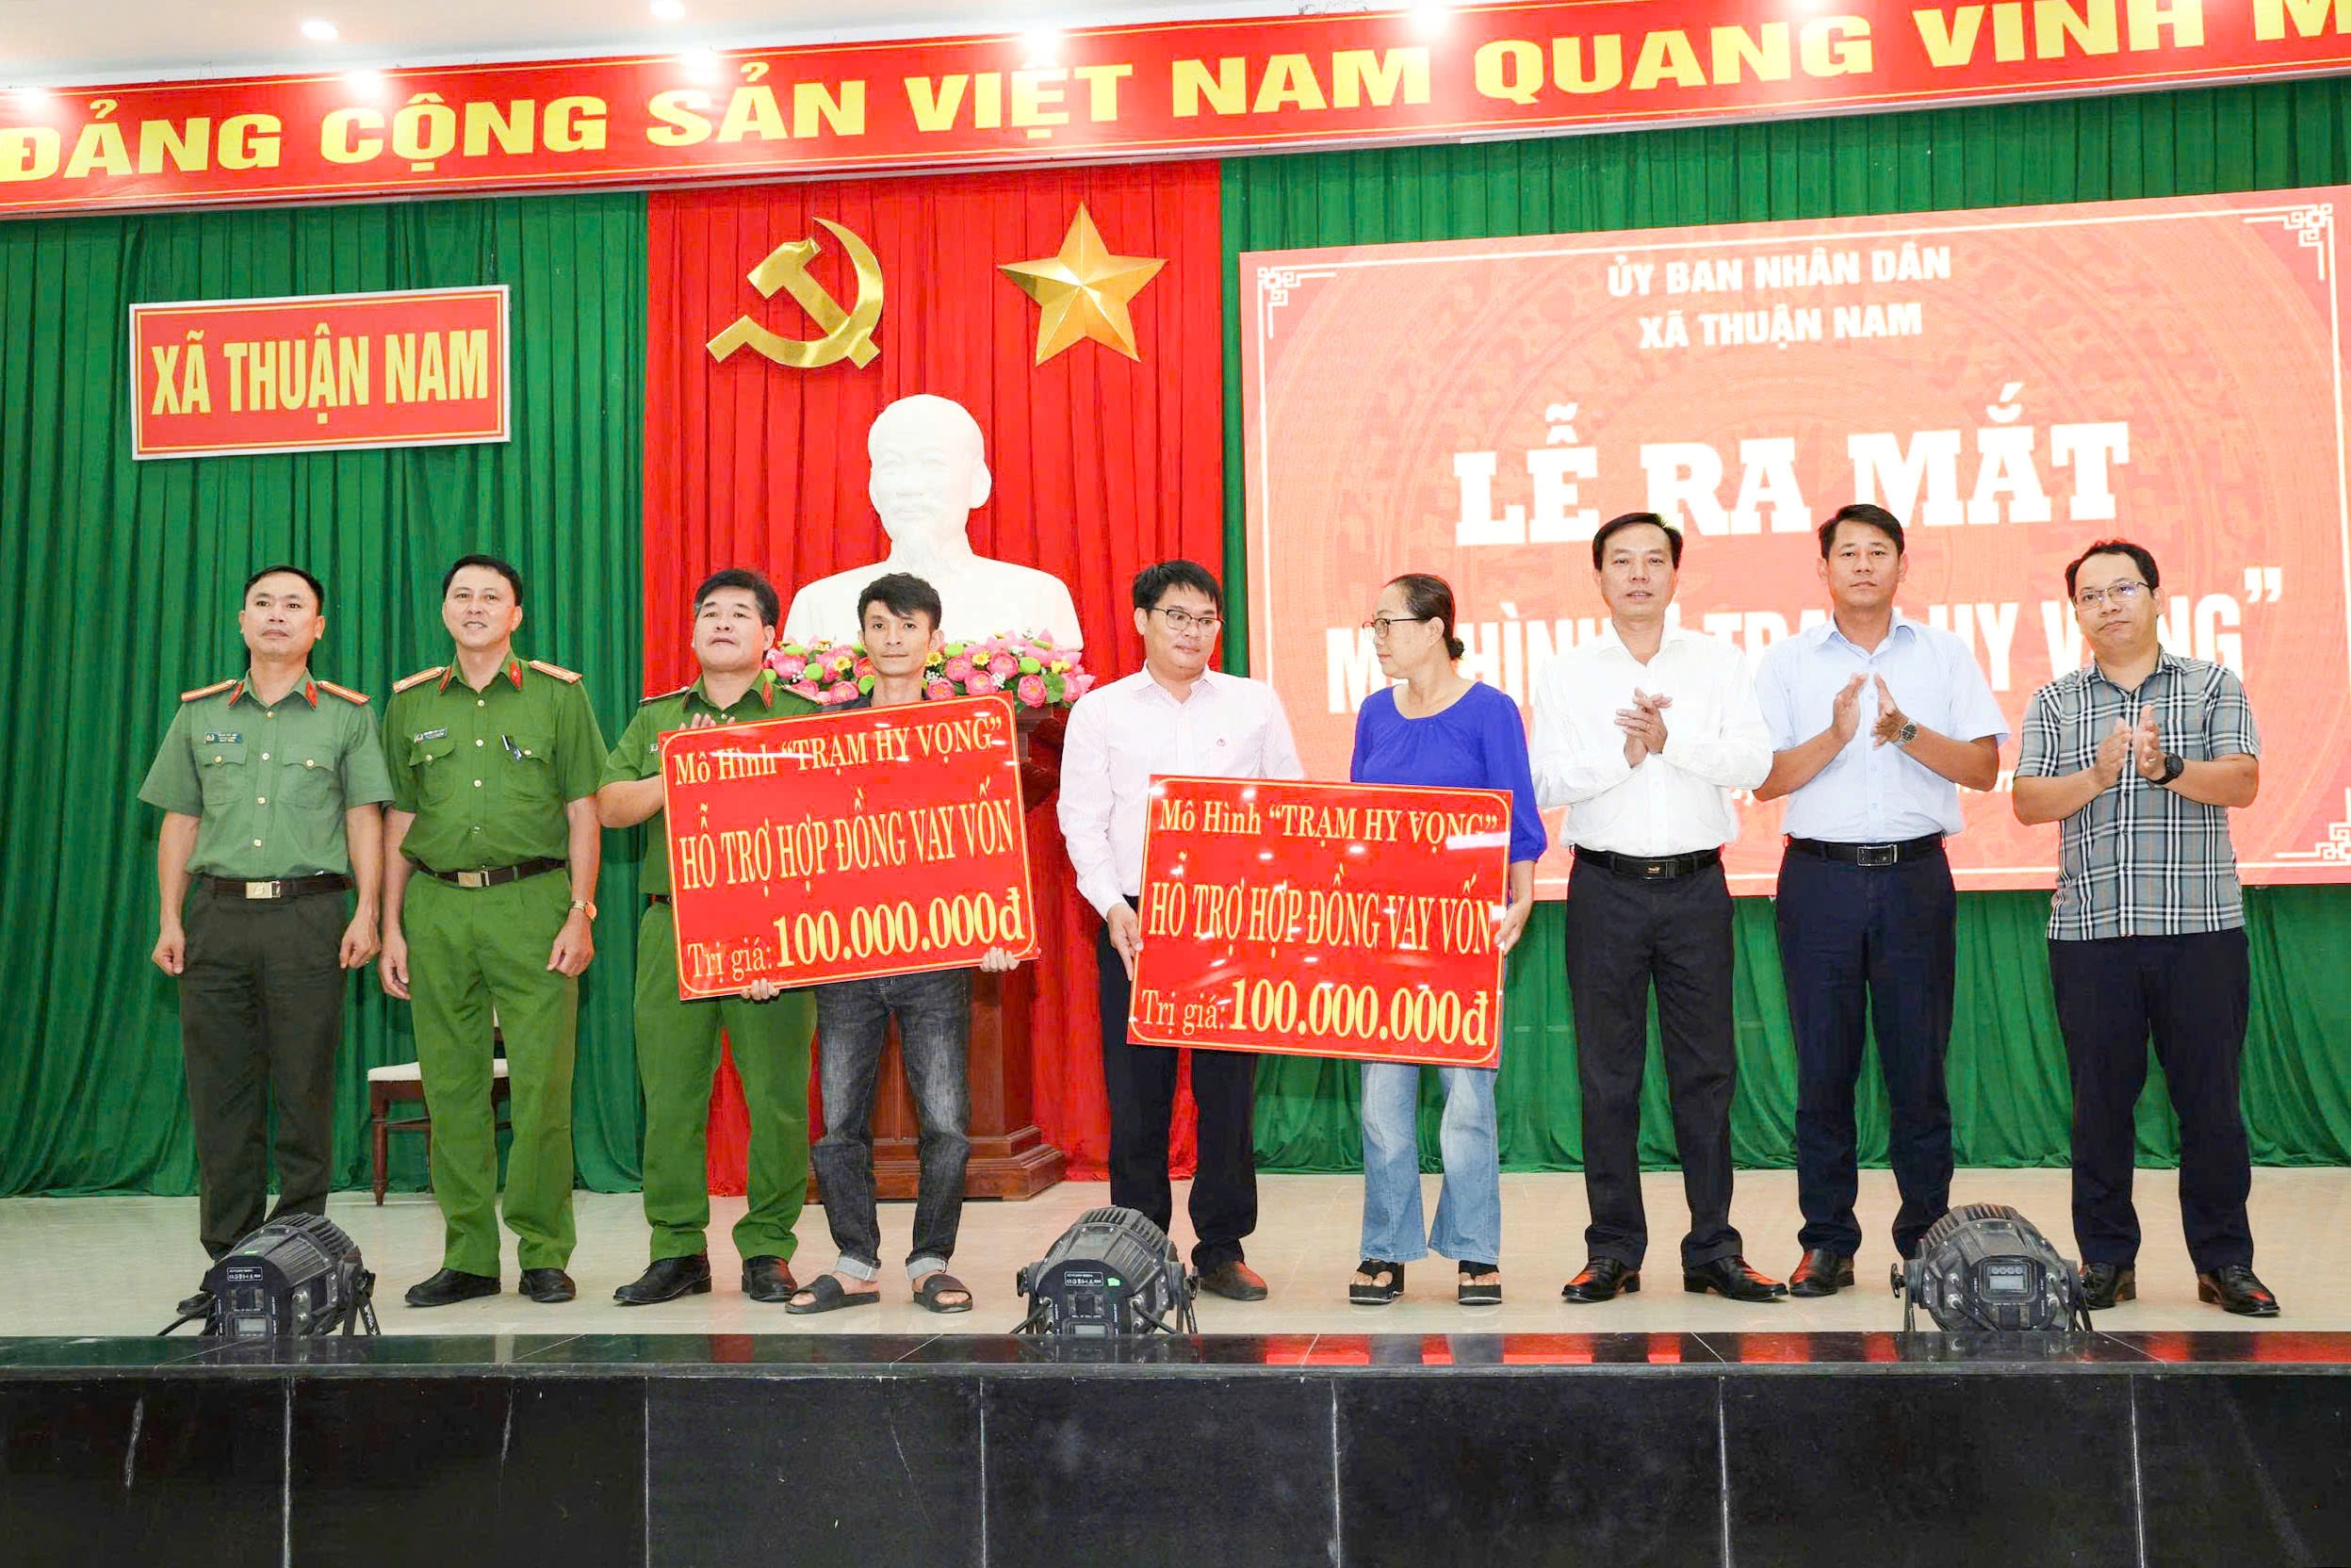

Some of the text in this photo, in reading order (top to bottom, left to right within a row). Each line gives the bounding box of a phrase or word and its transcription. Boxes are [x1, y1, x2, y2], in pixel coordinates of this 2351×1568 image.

[0, 99, 282, 182] ĐẢNG
[320, 92, 608, 172] CỘNG
[646, 61, 866, 147] SẢN
[904, 57, 1133, 139] VIỆT
[1171, 45, 1430, 118] NAM
[1475, 16, 1873, 104] QUANG
[1913, 0, 2205, 68] VINH
[1608, 241, 1951, 297] ỦY BAN NHÂN DÂN
[1640, 302, 1922, 350] XÃ THUẬN NAM
[151, 322, 488, 424] XÃ THUẬN NAM
[1454, 383, 2130, 547] LỄ RA MẮT
[674, 752, 711, 785] Mô
[717, 743, 776, 780] Hình
[875, 727, 910, 760] HY
[678, 776, 1015, 897] HỖ TRỢ HỢP ĐỒNG VAY VỐN
[1158, 798, 1196, 833] Mô
[1202, 800, 1262, 836] Hình
[1269, 804, 1357, 848] “TRẠM
[1363, 808, 1399, 842] HY
[1148, 851, 1494, 958] HỖ TRỢ HỢP ĐỒNG VAY VỐN
[688, 942, 725, 984] Trị
[1142, 989, 1175, 1035] Trị
